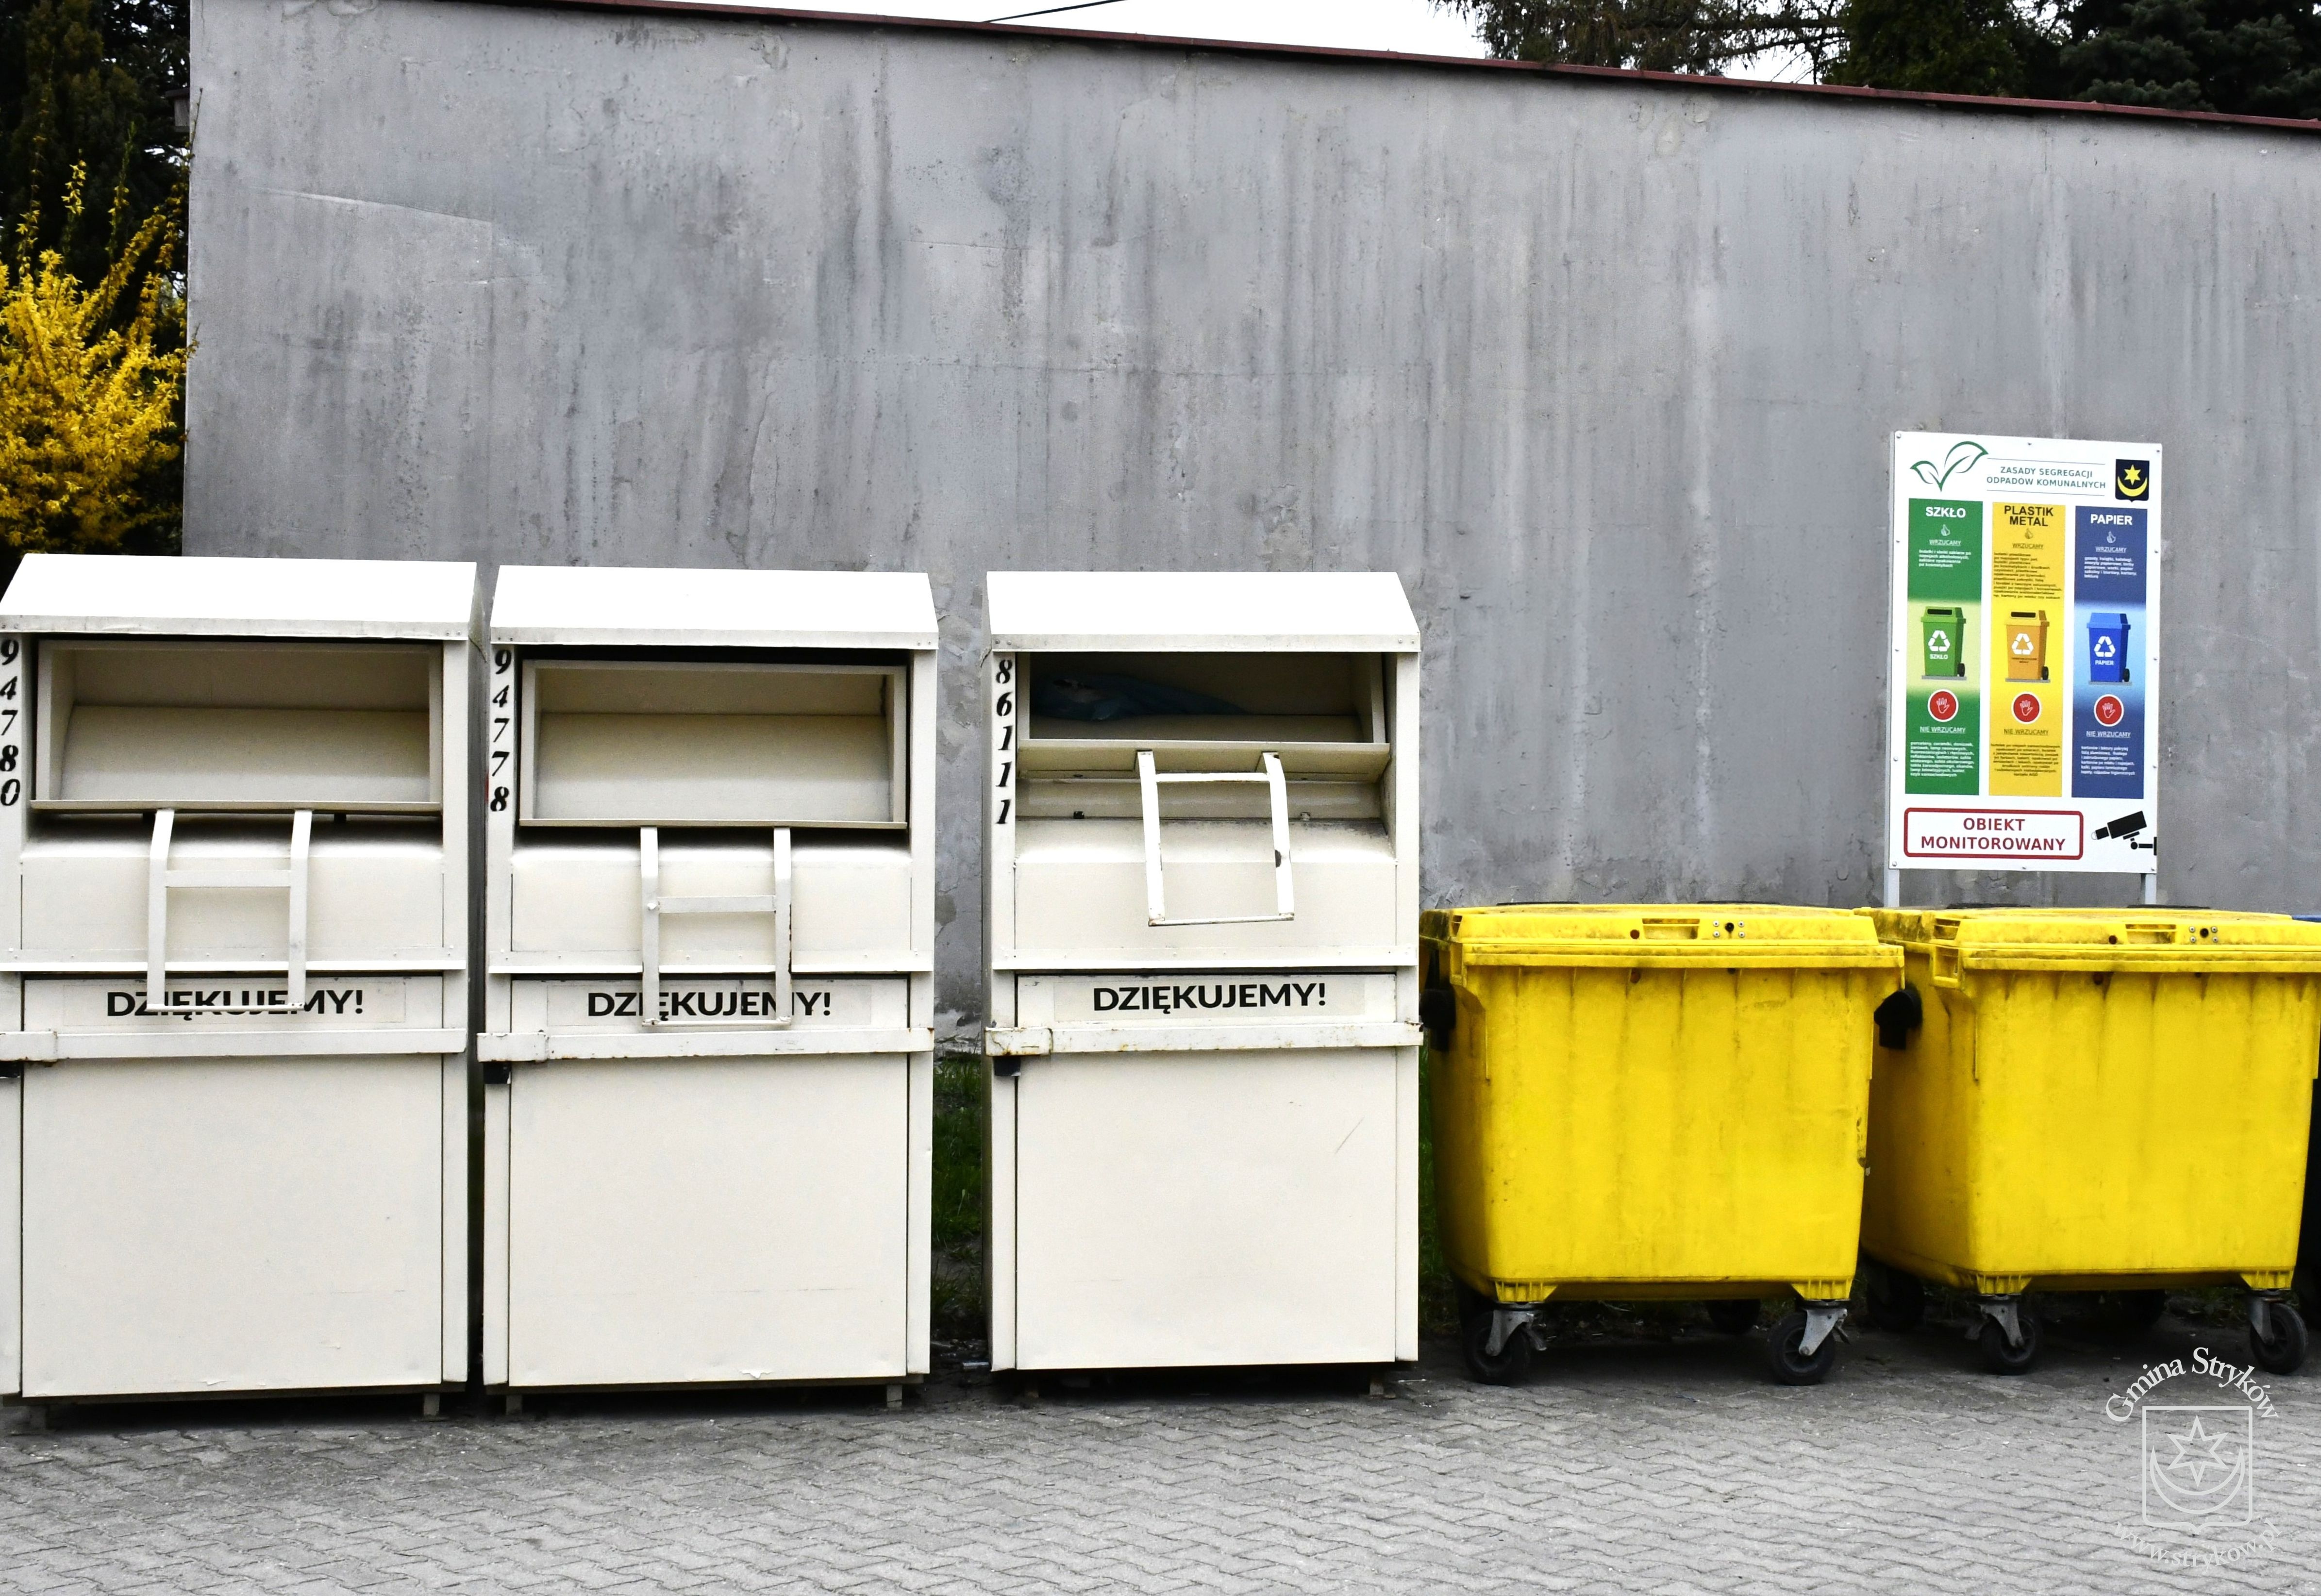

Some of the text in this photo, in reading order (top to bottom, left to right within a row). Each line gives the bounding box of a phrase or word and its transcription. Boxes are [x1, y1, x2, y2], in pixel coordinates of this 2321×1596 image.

[2000, 466, 2093, 479] ZASADY SEGREGACJI
[1987, 475, 2106, 489] ODPADÓW KOMUNALNYCH
[1925, 506, 1966, 518] SZKŁO
[2004, 505, 2054, 517] PLASTIK
[2009, 515, 2049, 527] METAL
[2090, 514, 2133, 525] PAPIER
[490, 649, 512, 812] 94778
[996, 659, 1013, 824] 86111
[1963, 817, 2025, 831] OBIEKT
[1921, 836, 2066, 851] MONITOROWANY
[1094, 983, 1326, 1014] DZIĘKUJEMY!
